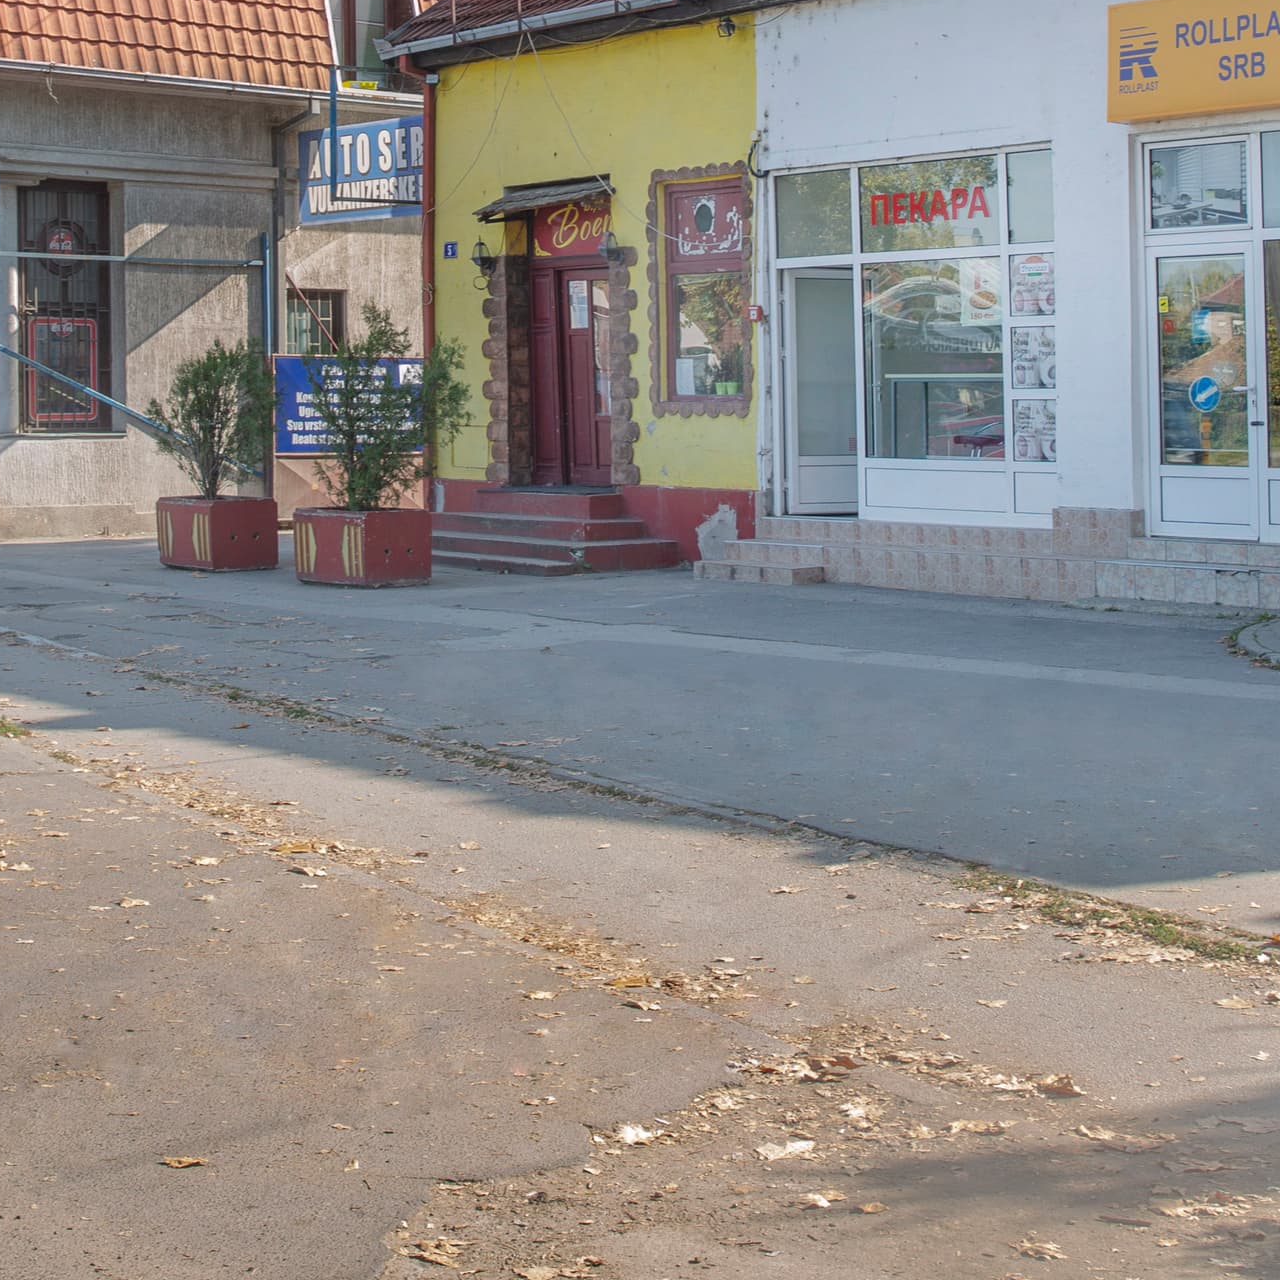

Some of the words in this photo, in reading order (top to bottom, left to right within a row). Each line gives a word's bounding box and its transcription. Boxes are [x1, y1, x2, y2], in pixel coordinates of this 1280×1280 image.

[1218, 51, 1266, 81] SRB
[1119, 81, 1159, 94] ROLLPLAST
[871, 186, 991, 226] ПЕКАРА
[287, 420, 303, 431] Sve
